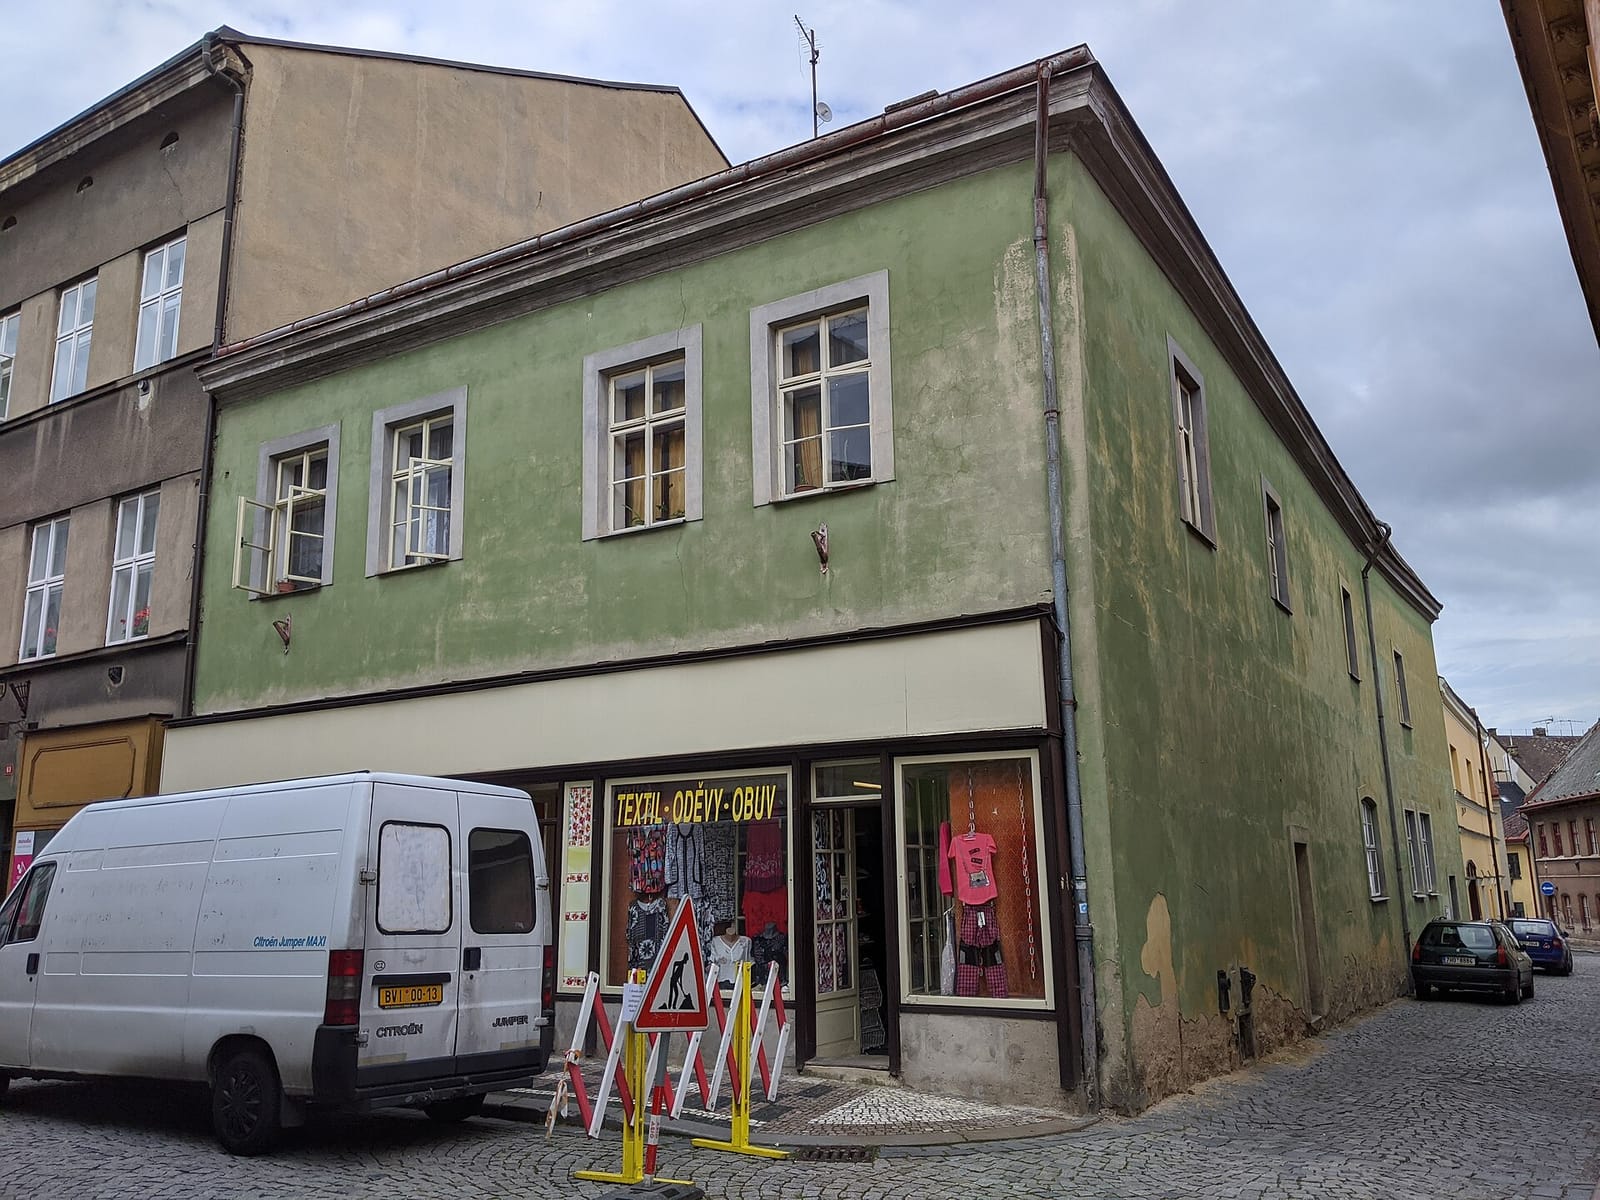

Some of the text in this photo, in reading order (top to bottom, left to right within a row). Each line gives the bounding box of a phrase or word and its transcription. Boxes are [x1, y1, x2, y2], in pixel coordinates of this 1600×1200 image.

[617, 781, 776, 826] TEXTIL ODĚVY OBUV
[278, 936, 305, 949] Jumper
[306, 935, 327, 947] MAXI
[385, 987, 438, 1003] BVI 00-13
[492, 1015, 528, 1027] JUMPER
[376, 1022, 423, 1038] CITROËN
